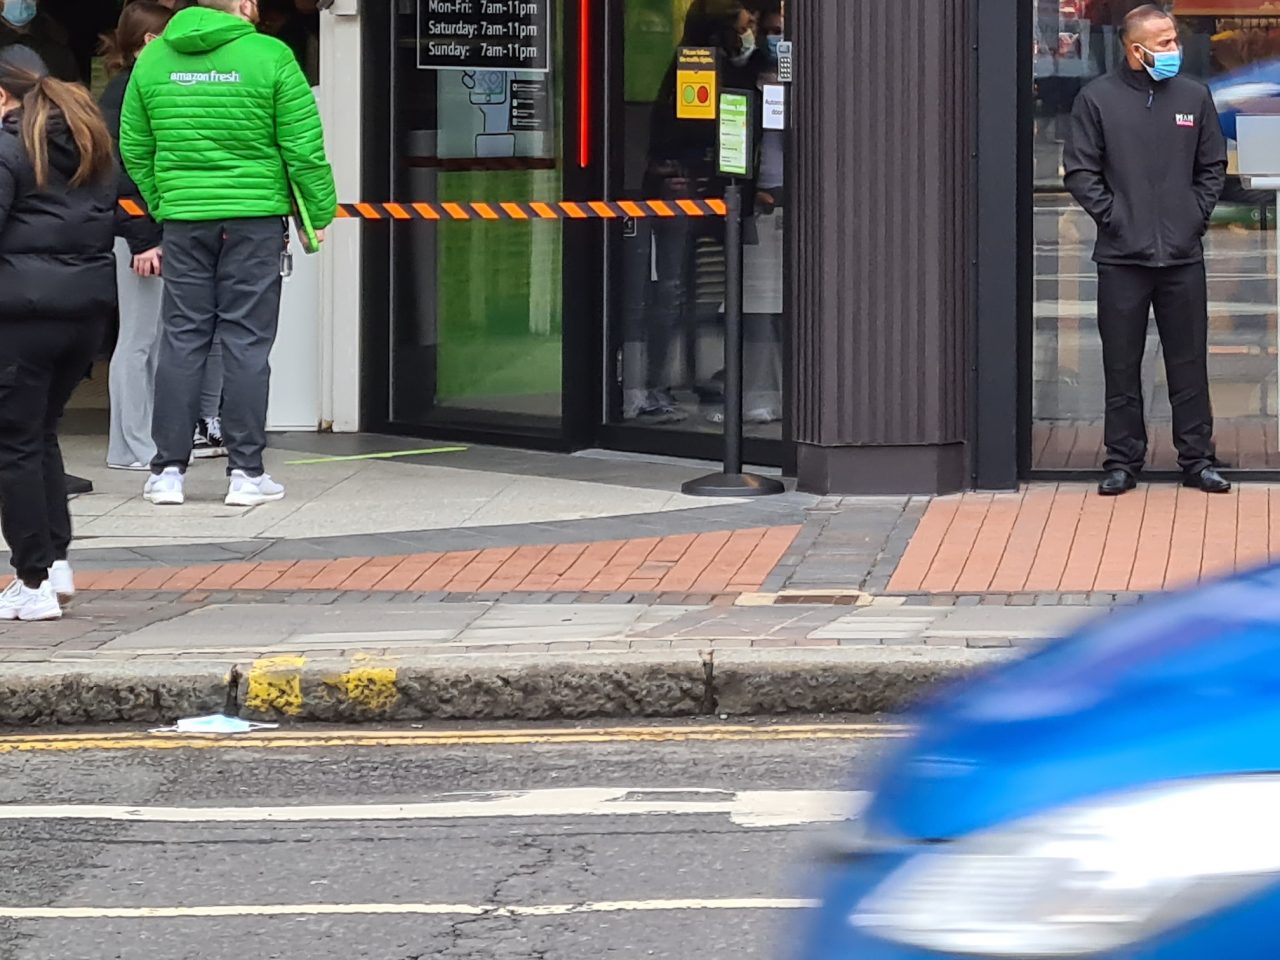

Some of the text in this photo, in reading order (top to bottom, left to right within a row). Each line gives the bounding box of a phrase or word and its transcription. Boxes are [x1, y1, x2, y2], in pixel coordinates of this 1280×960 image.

[428, 0, 537, 18] Mon-Fri: 7am-11pm
[428, 20, 537, 39] Saturday: 7am-11pm
[428, 42, 537, 61] Sunday: 7am-11pm
[170, 70, 240, 82] amazon fresh
